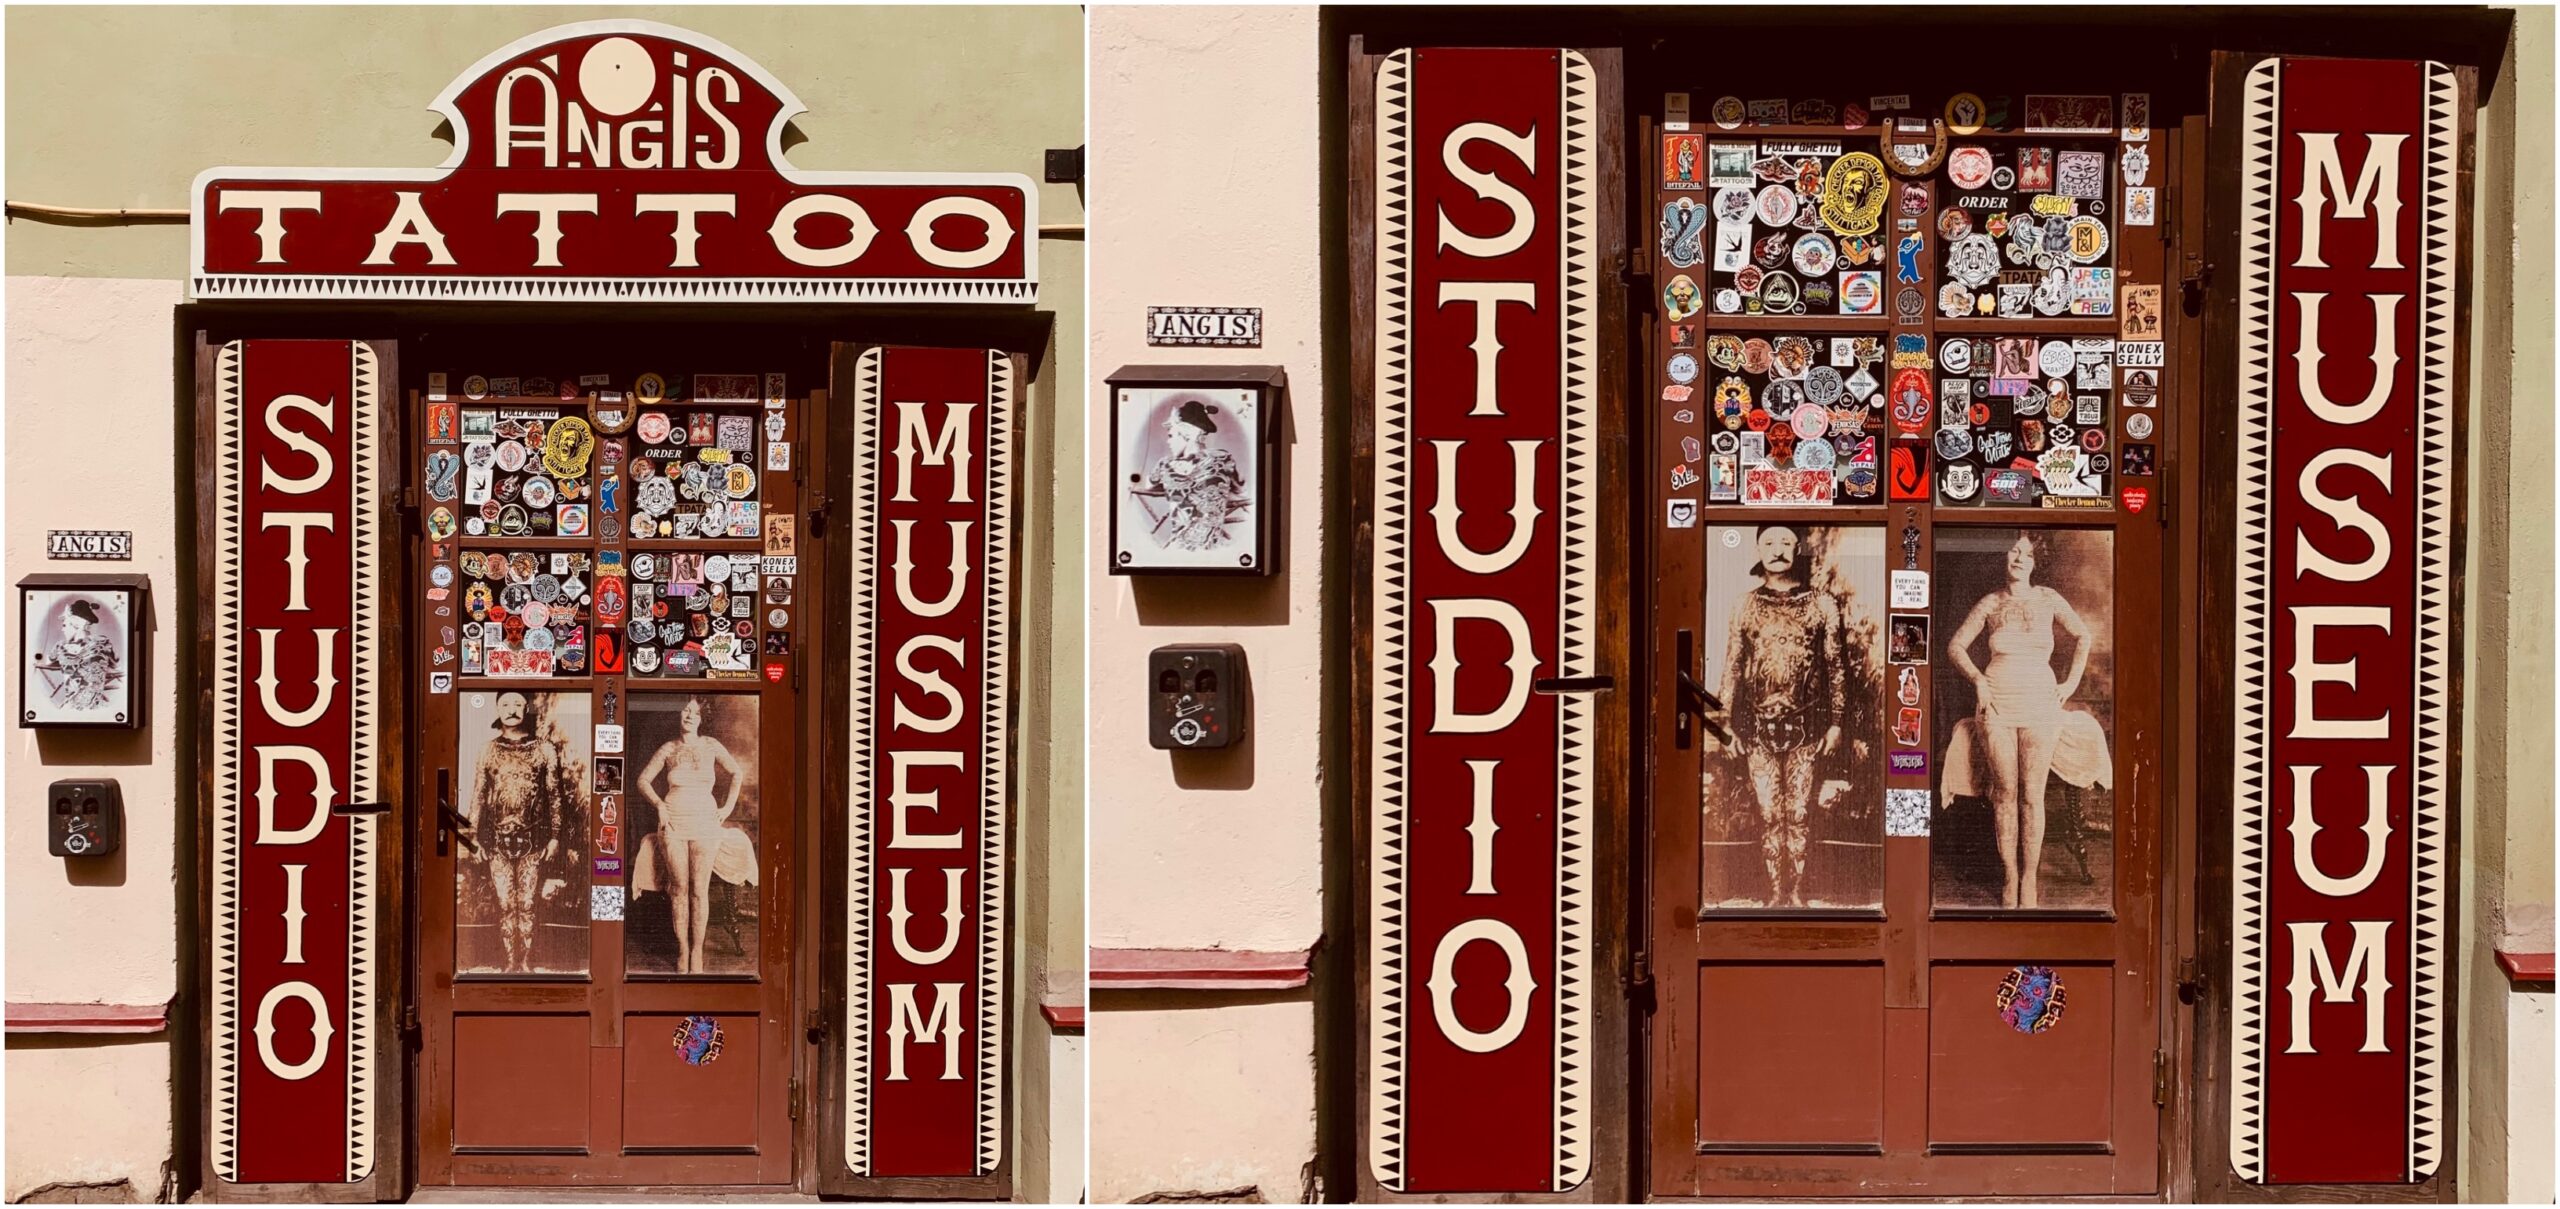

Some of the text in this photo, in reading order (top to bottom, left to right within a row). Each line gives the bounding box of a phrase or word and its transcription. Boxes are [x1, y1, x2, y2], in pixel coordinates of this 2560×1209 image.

[1766, 141, 1838, 153] FULLY GHETTO
[1831, 159, 1850, 191] CHECKER
[1850, 158, 1876, 172] DEMON
[1959, 196, 2009, 209] ORDER
[1826, 207, 1873, 230] STUTTGART
[219, 190, 1016, 269] TATTOO
[2074, 216, 2093, 225] MAIN
[2093, 217, 2107, 248] TATTOO
[2075, 268, 2111, 280] JPEG
[1160, 315, 1247, 336] ANGIS
[2118, 343, 2162, 354] KONEX
[2118, 354, 2162, 365] SELLY
[503, 408, 556, 417] FULLY GHETTO
[645, 449, 682, 459] ORDER
[731, 502, 758, 511] JPEG
[58, 536, 121, 552] ANGIS
[762, 557, 795, 565] KONEX
[762, 565, 795, 573] SELLY
[1427, 122, 1543, 1053] STUDIO
[2286, 132, 2410, 1054] MUSEUM
[254, 394, 339, 1080] STUDIO
[886, 402, 978, 1081] MUSEUM
